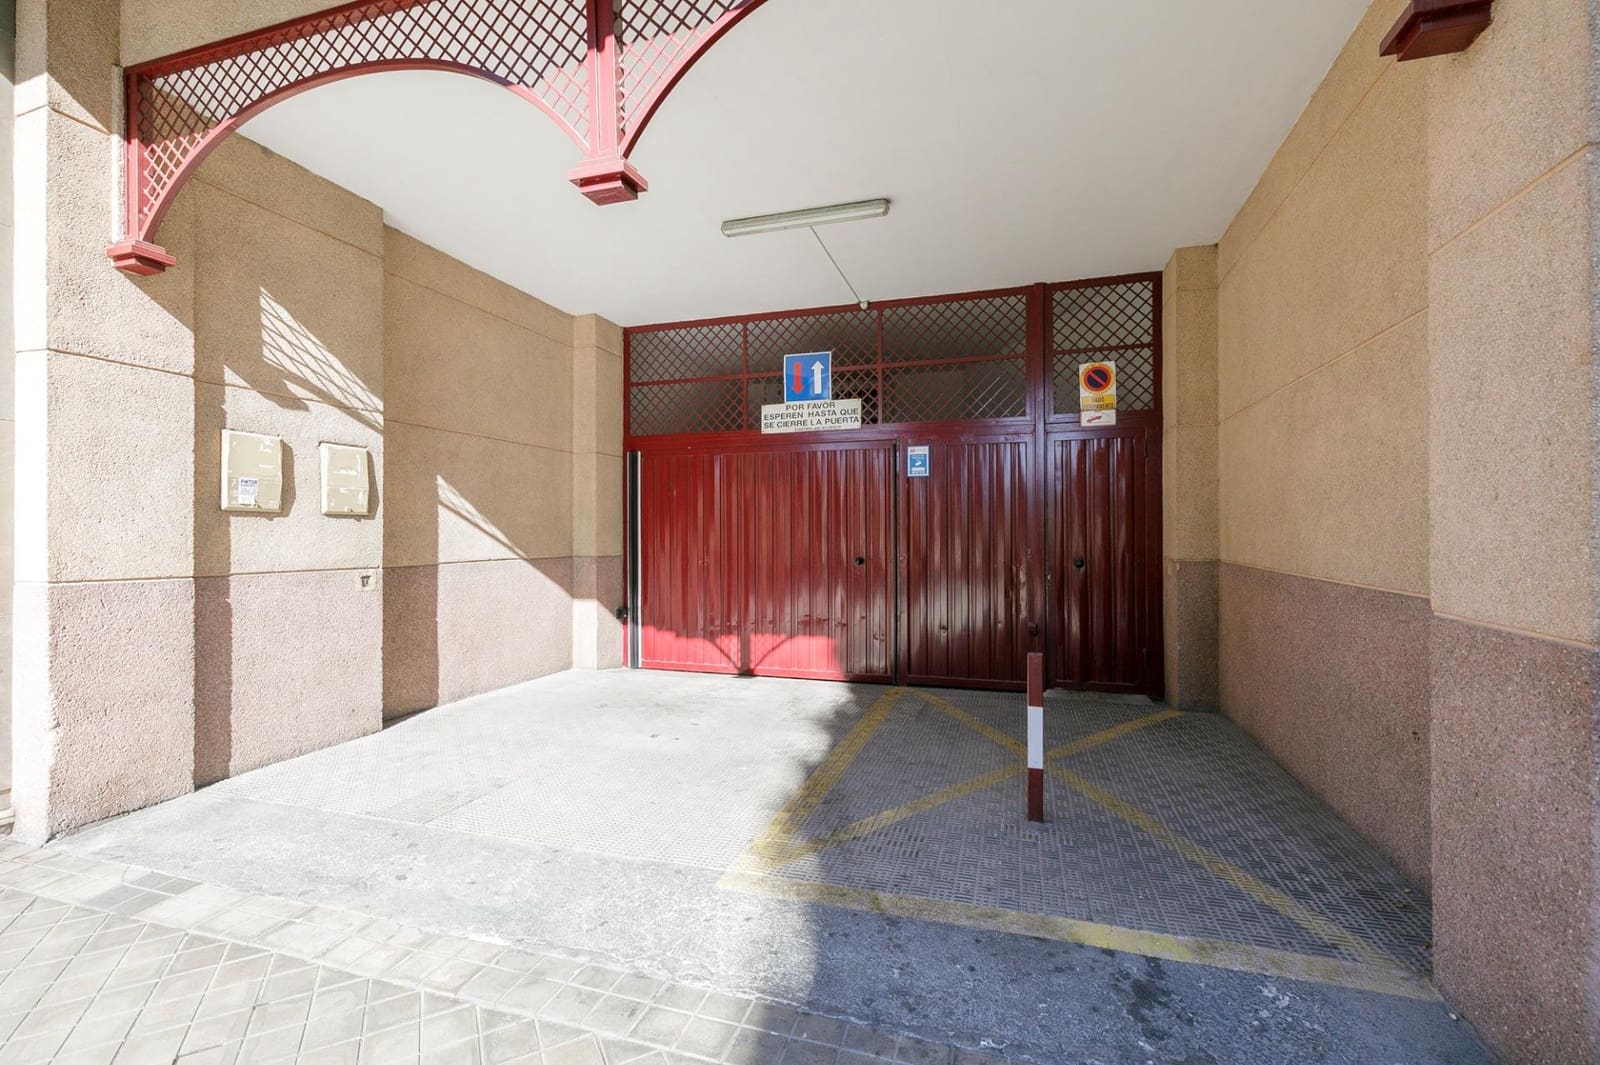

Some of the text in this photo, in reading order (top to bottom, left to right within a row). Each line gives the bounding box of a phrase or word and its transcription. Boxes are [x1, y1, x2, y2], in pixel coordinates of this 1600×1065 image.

[785, 401, 836, 411] POR FAVOR
[763, 408, 859, 421] ESPEREN HASTA QUE
[763, 421, 775, 429] SE
[776, 419, 808, 428] CIERRE
[810, 418, 822, 426] LA
[824, 416, 860, 425] PUERTA
